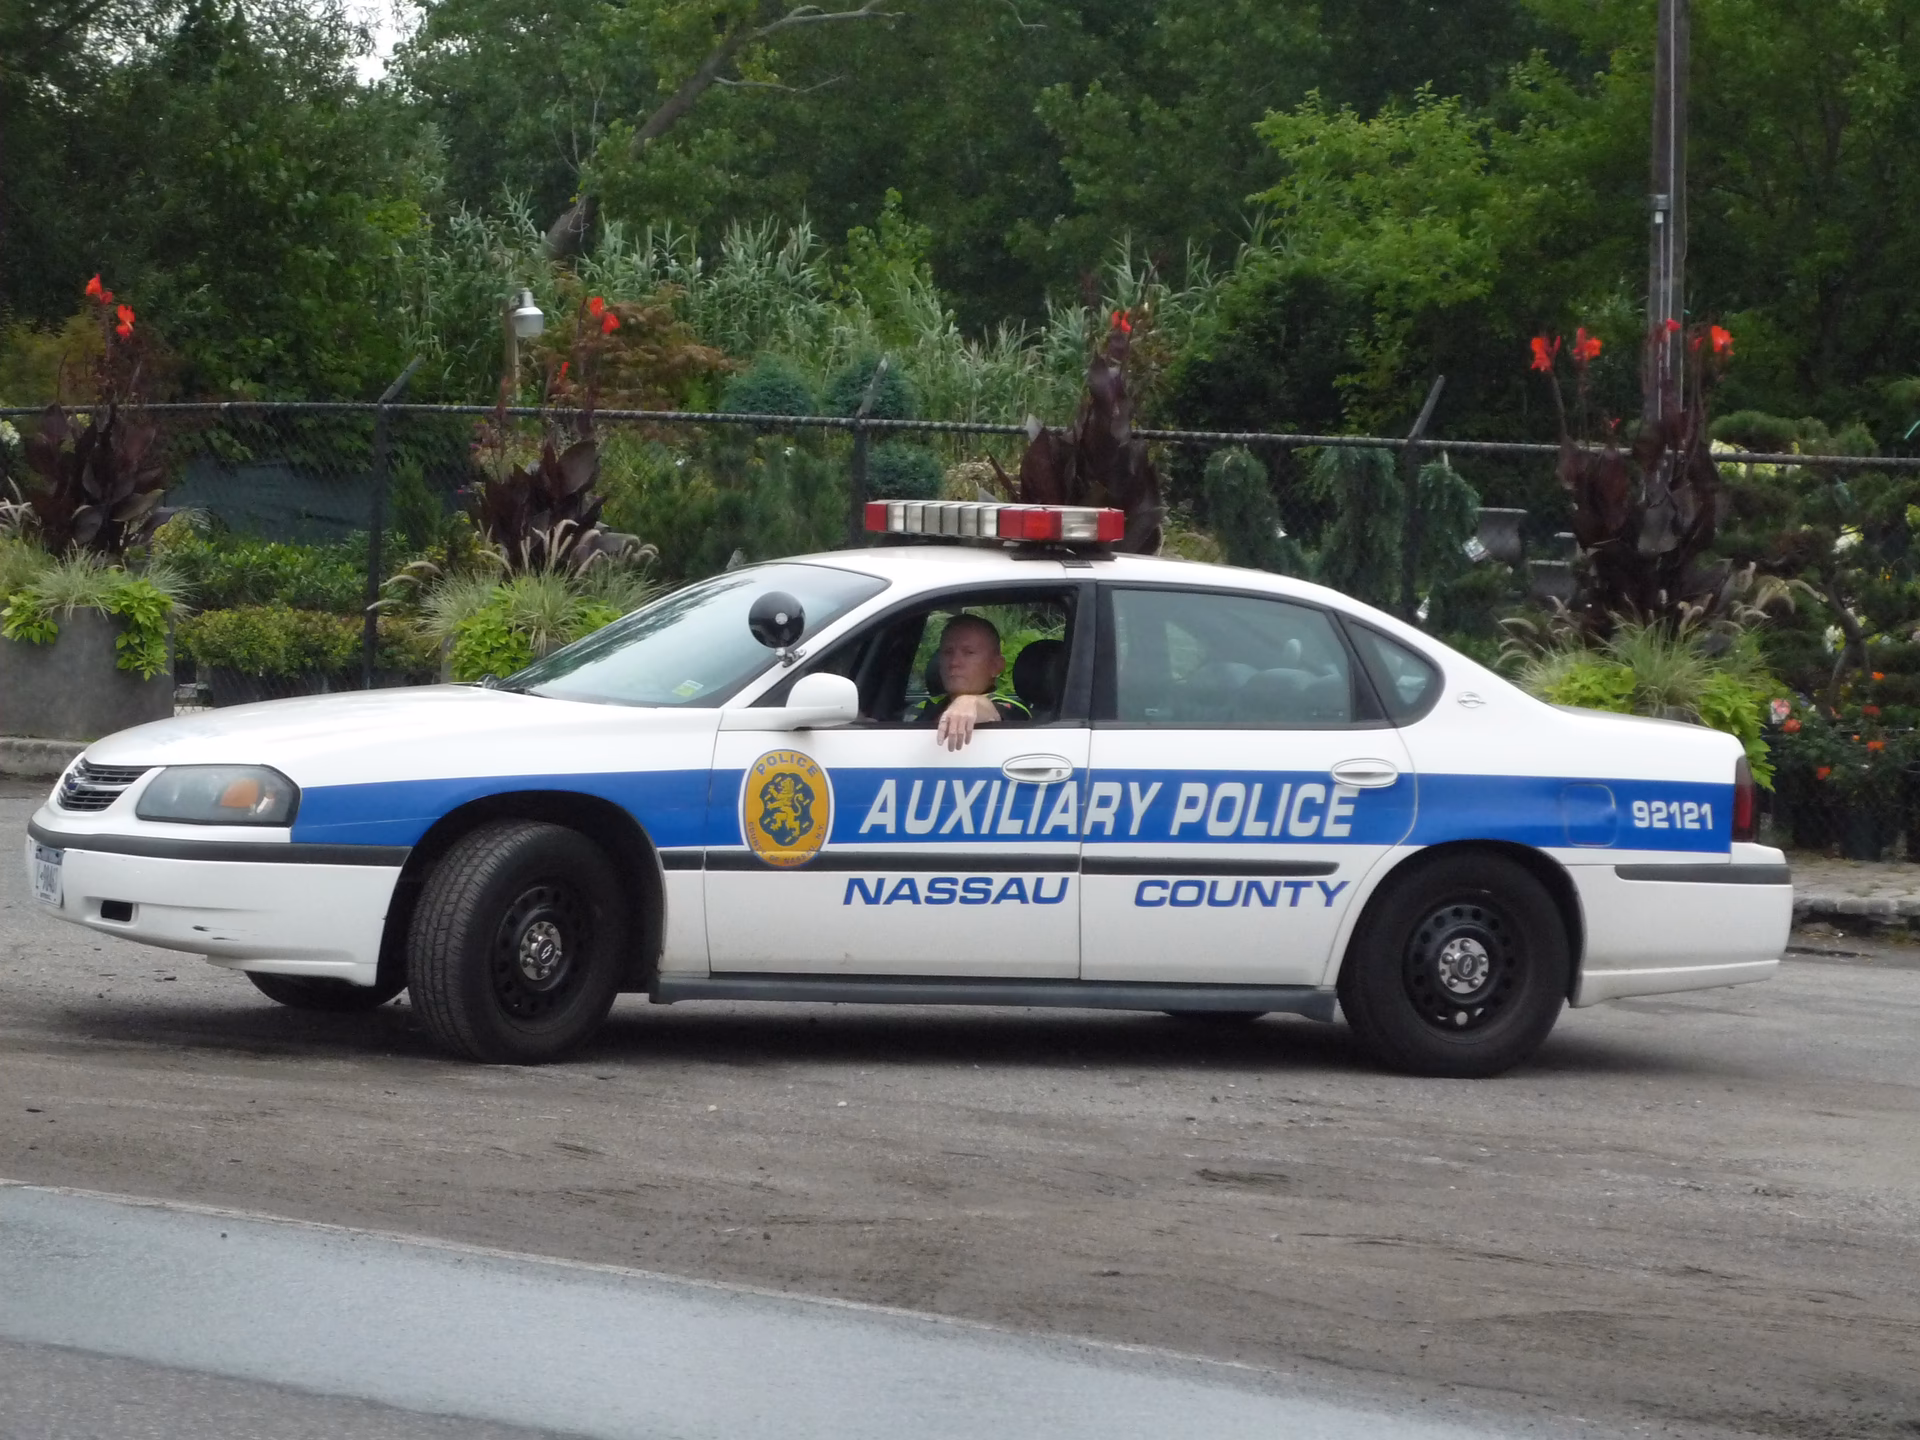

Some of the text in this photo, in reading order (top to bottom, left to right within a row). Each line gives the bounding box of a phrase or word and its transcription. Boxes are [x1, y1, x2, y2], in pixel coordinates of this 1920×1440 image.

[756, 754, 818, 777] POLICE
[858, 778, 1361, 838] AUXILIARY POLICE
[1632, 800, 1714, 830] 92121
[842, 876, 1352, 908] NASSAU COUNTY
